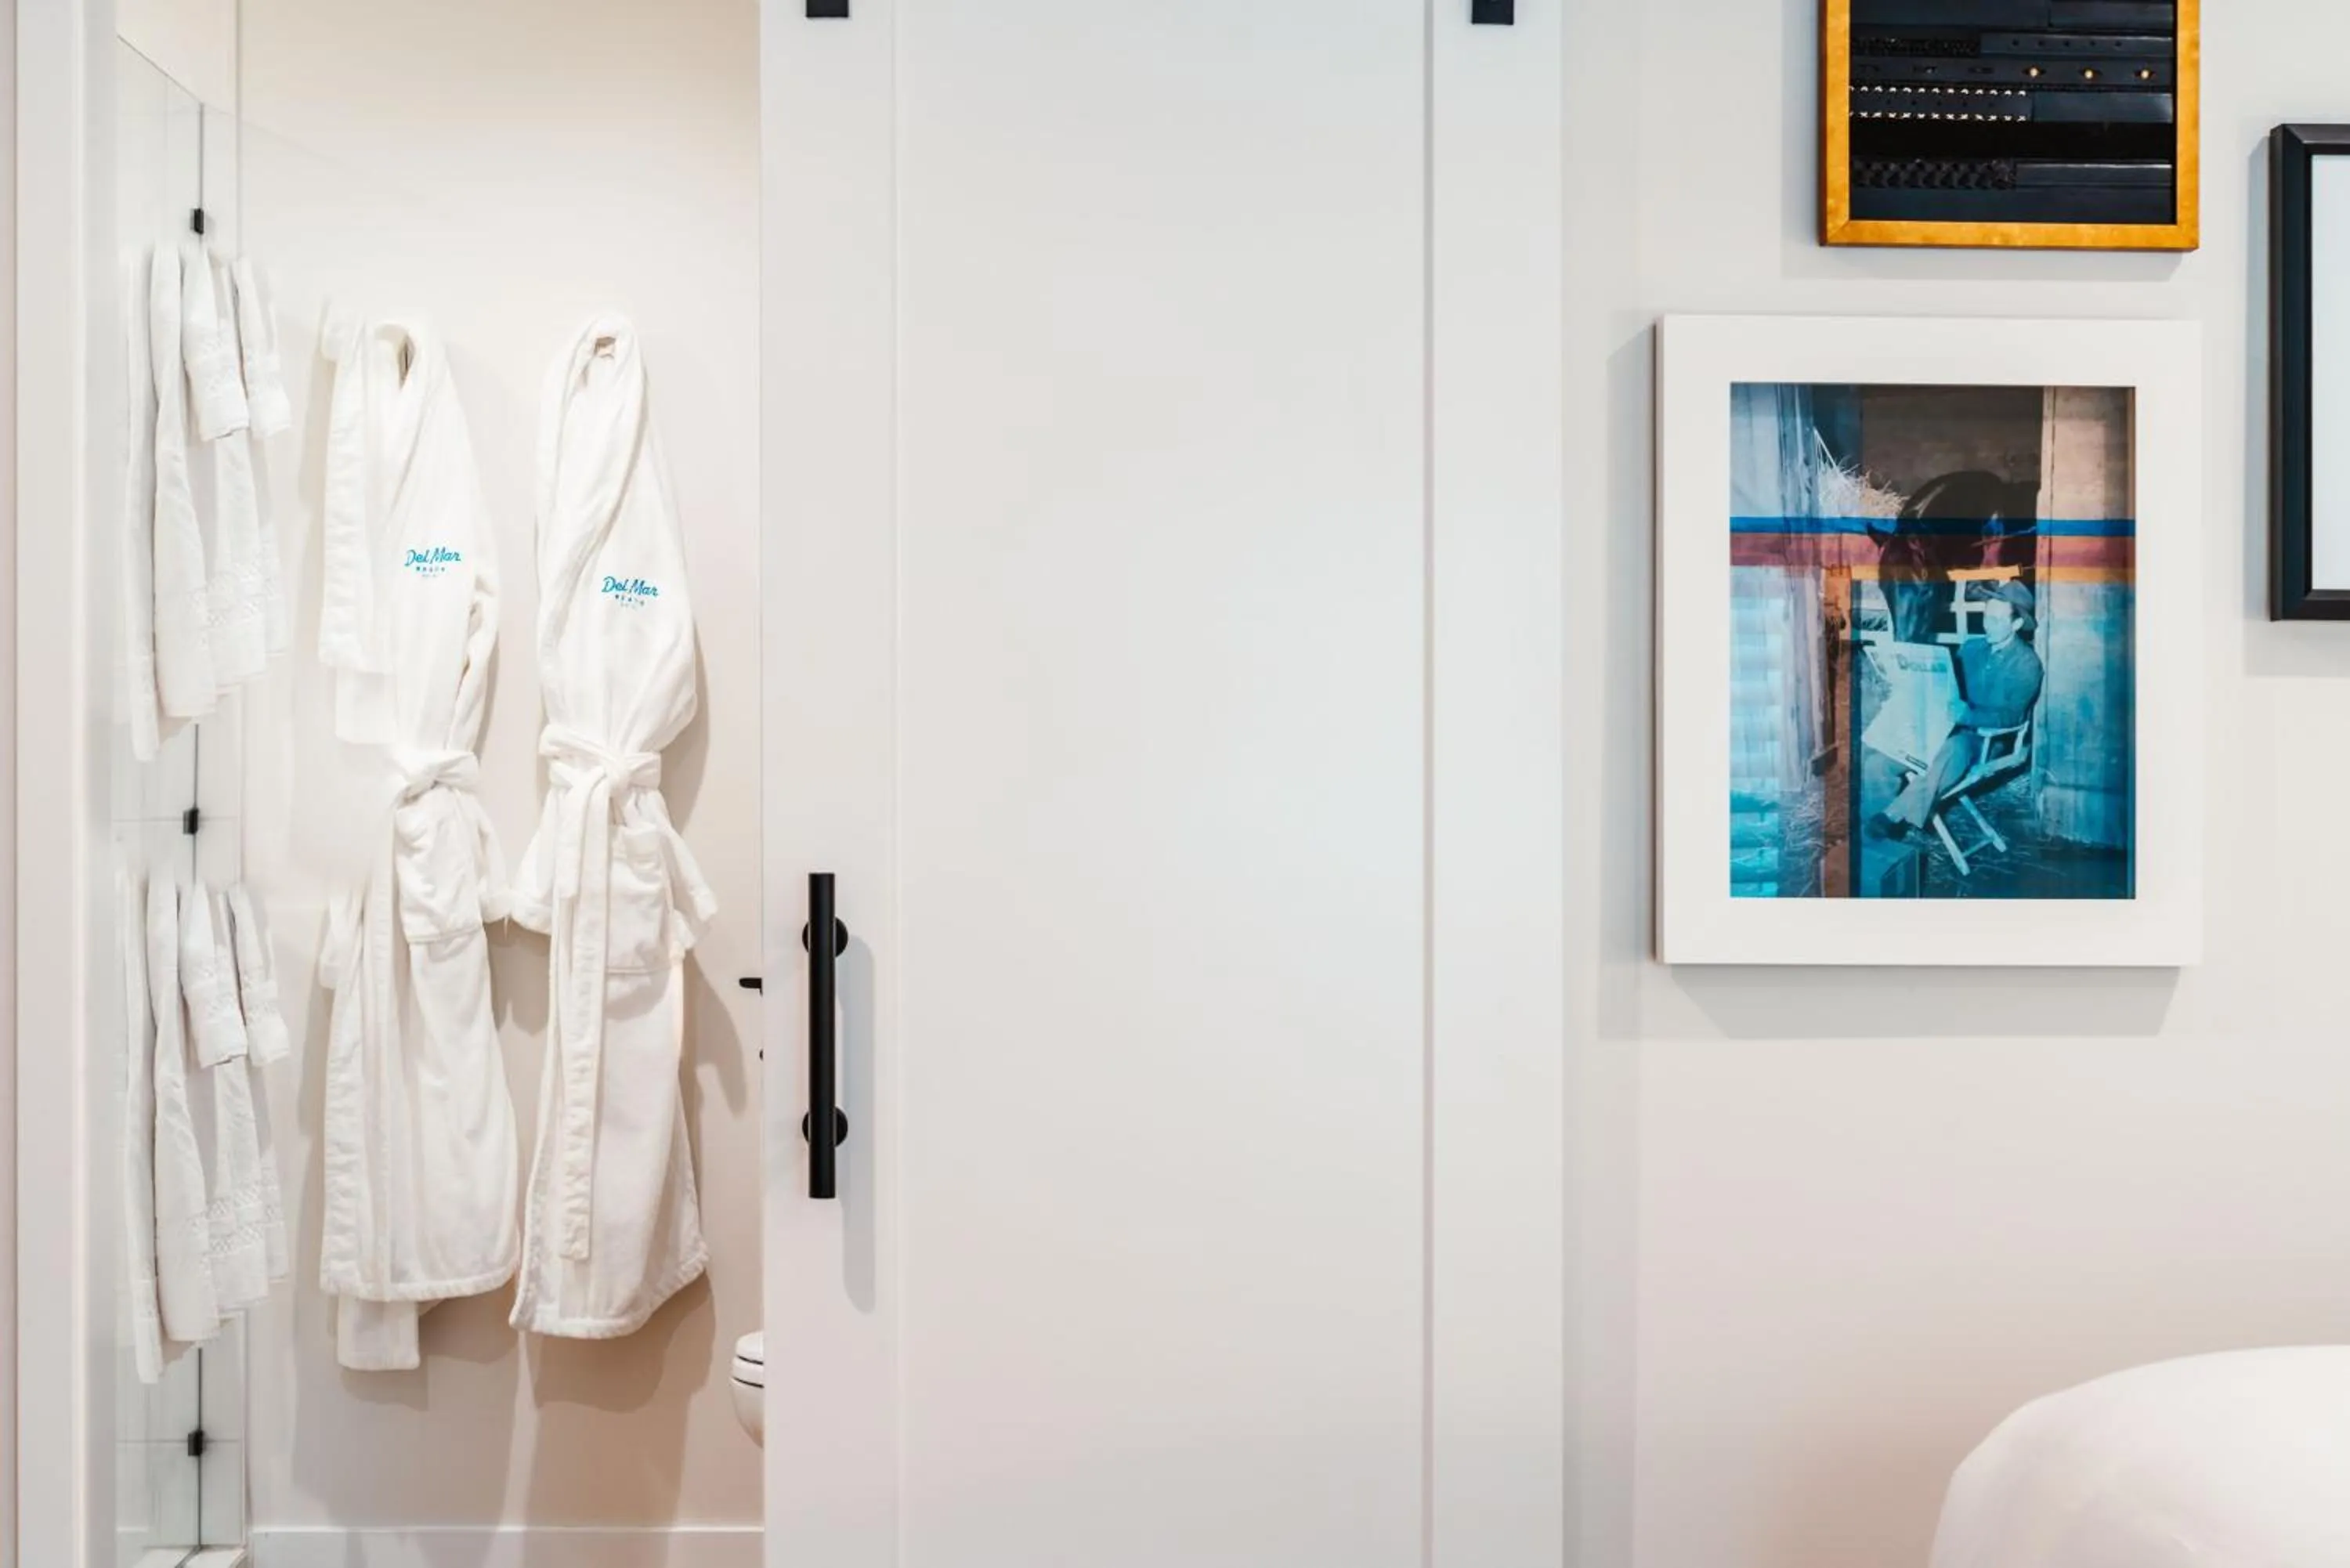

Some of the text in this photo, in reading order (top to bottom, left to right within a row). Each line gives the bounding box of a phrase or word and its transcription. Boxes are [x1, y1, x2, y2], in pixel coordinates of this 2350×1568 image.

[404, 547, 461, 566] Del Mar
[601, 576, 659, 597] Del Mar
